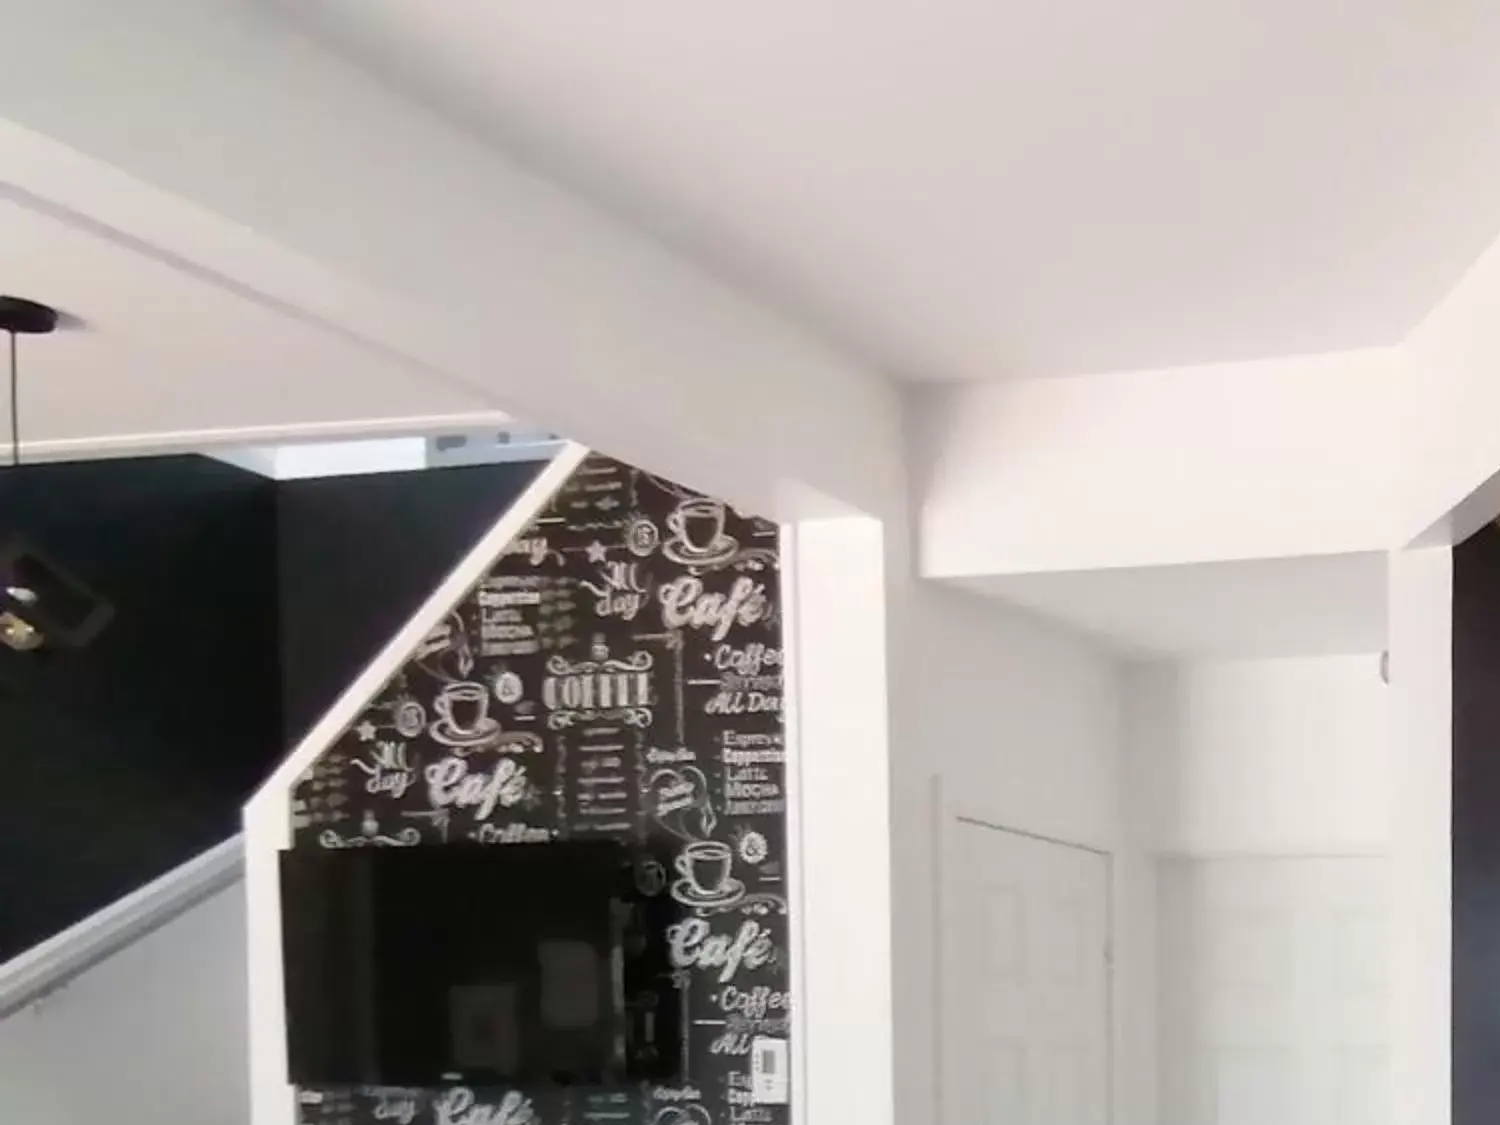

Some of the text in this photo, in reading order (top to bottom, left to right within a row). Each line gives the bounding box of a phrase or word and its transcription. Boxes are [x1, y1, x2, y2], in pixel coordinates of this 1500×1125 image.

[659, 576, 766, 641] Café
[747, 692, 781, 713] Da
[425, 756, 527, 821] Café
[666, 918, 773, 983] Café
